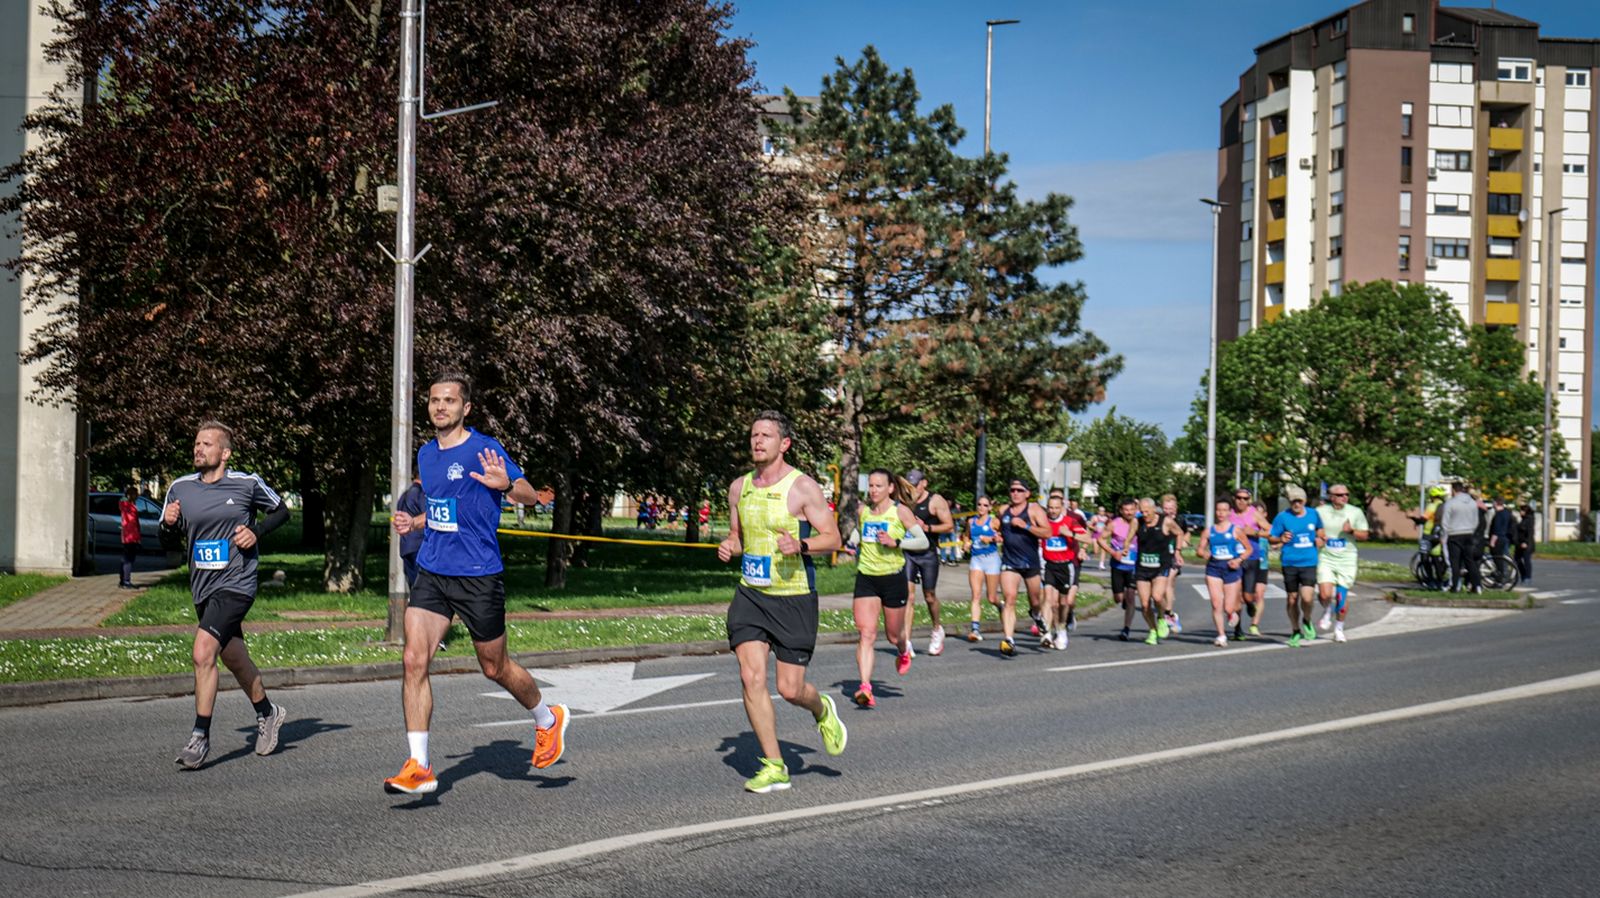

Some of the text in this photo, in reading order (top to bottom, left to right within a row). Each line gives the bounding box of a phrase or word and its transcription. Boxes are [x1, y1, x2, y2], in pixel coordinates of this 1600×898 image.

[430, 505, 450, 521] 143
[198, 548, 220, 561] 181
[745, 561, 764, 577] 364
